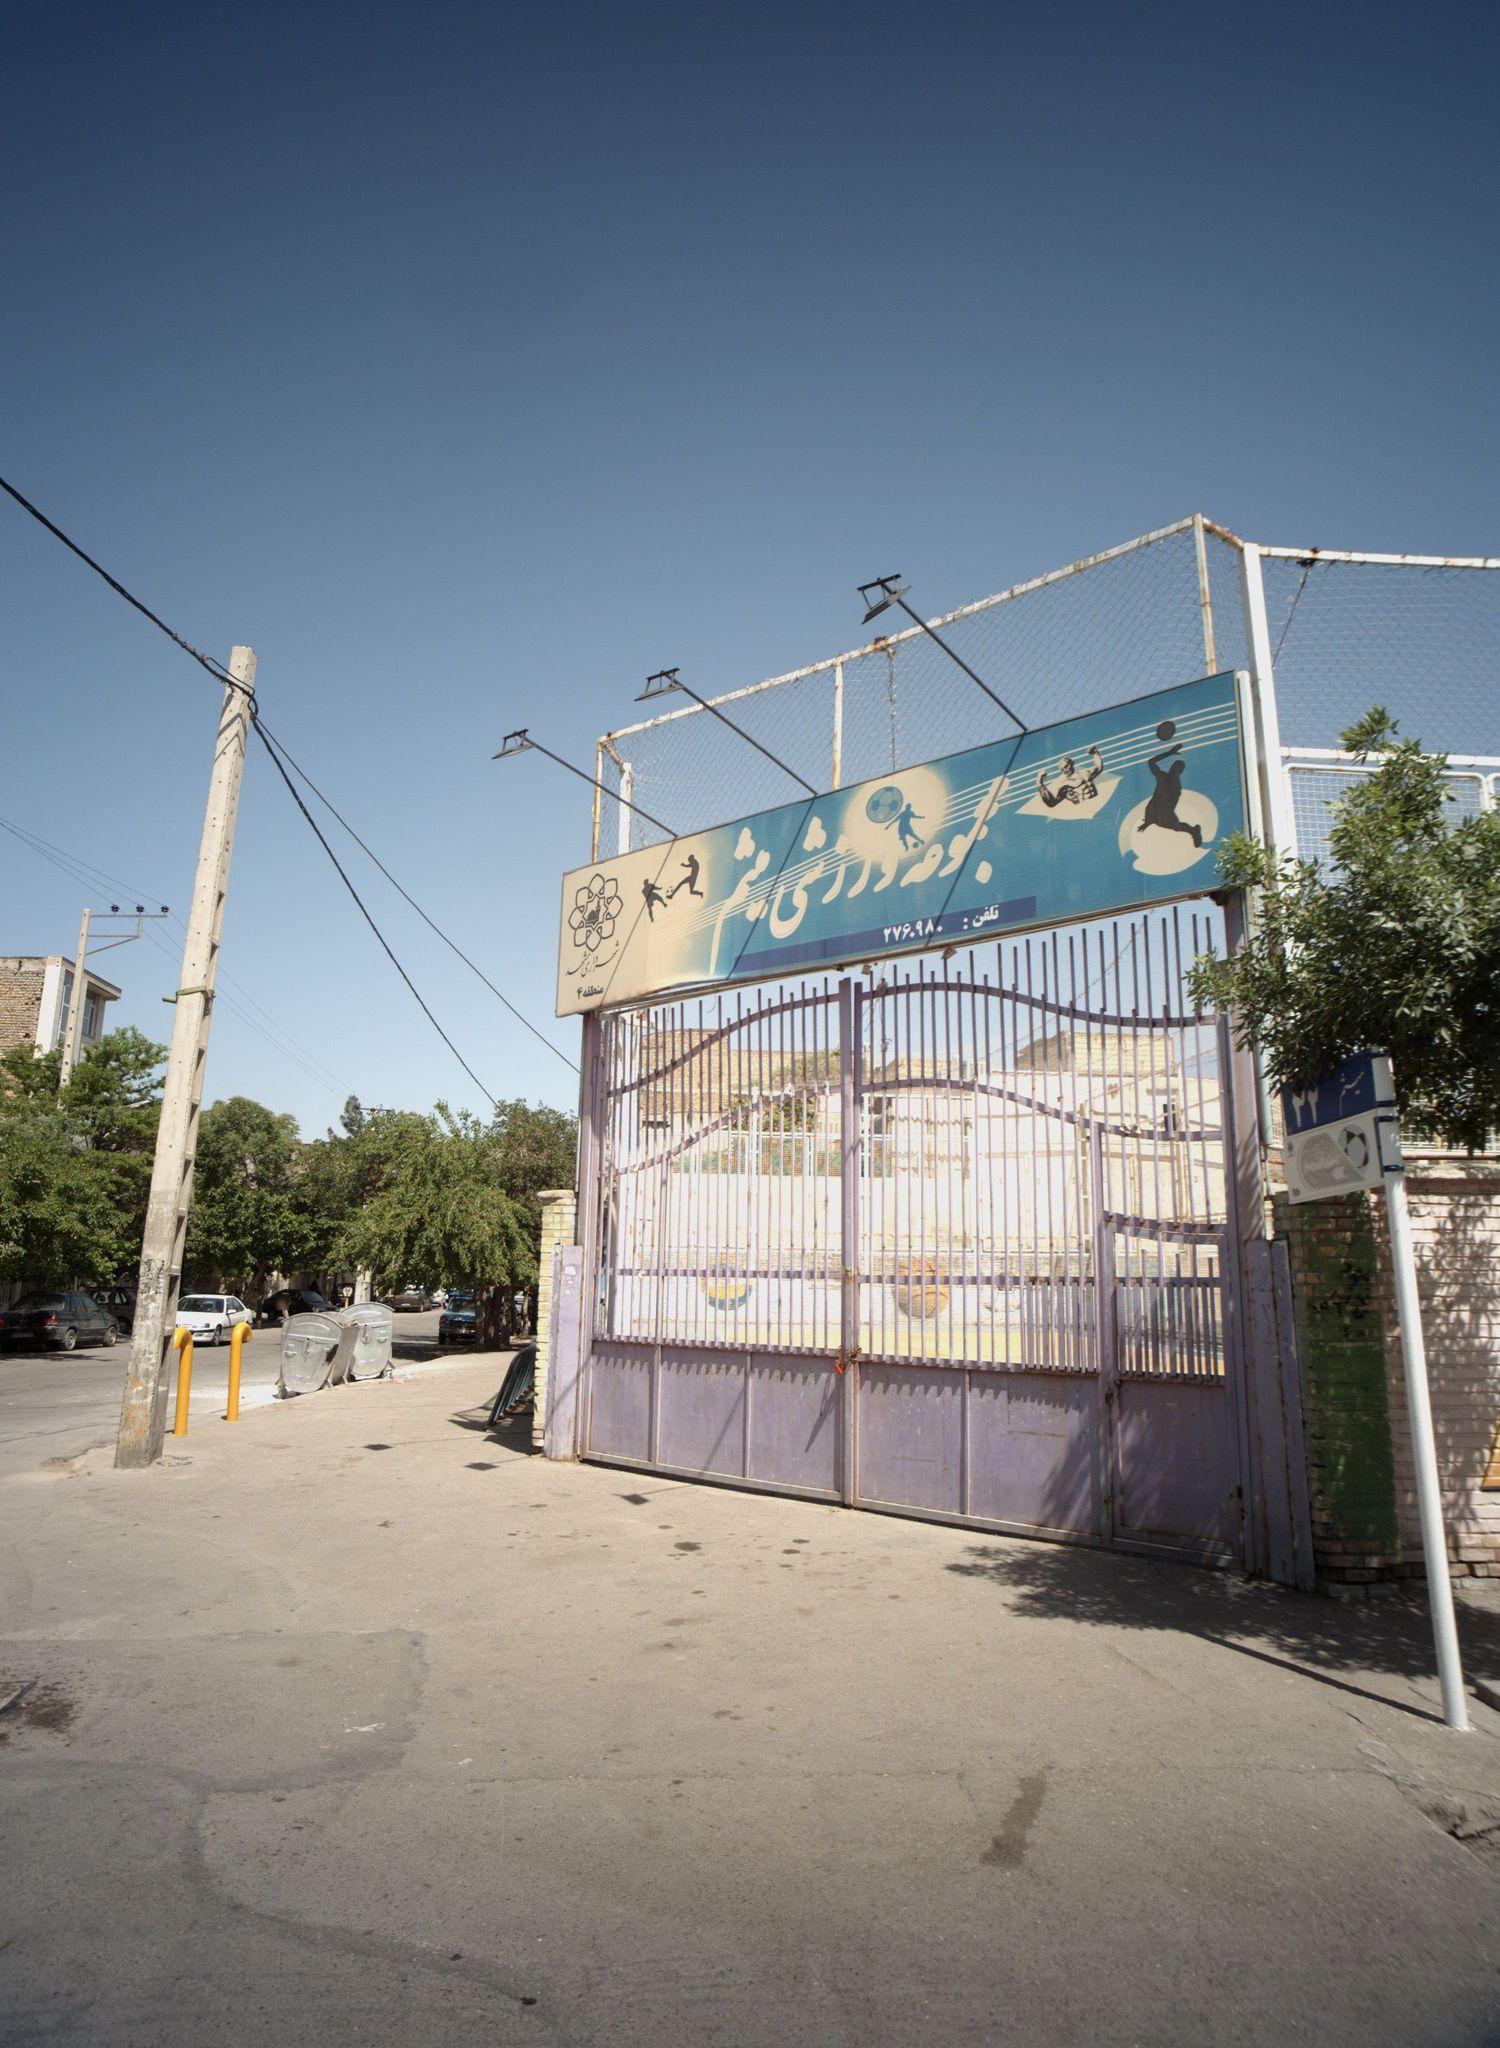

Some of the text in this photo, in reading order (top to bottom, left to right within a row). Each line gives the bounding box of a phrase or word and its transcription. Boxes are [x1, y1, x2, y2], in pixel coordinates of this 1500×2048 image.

[708, 775, 1010, 976] مجموعه ورزشی میثم
[883, 918, 943, 943] ۲۷۶۰۹۸۰
[583, 986, 604, 997] منطقه
